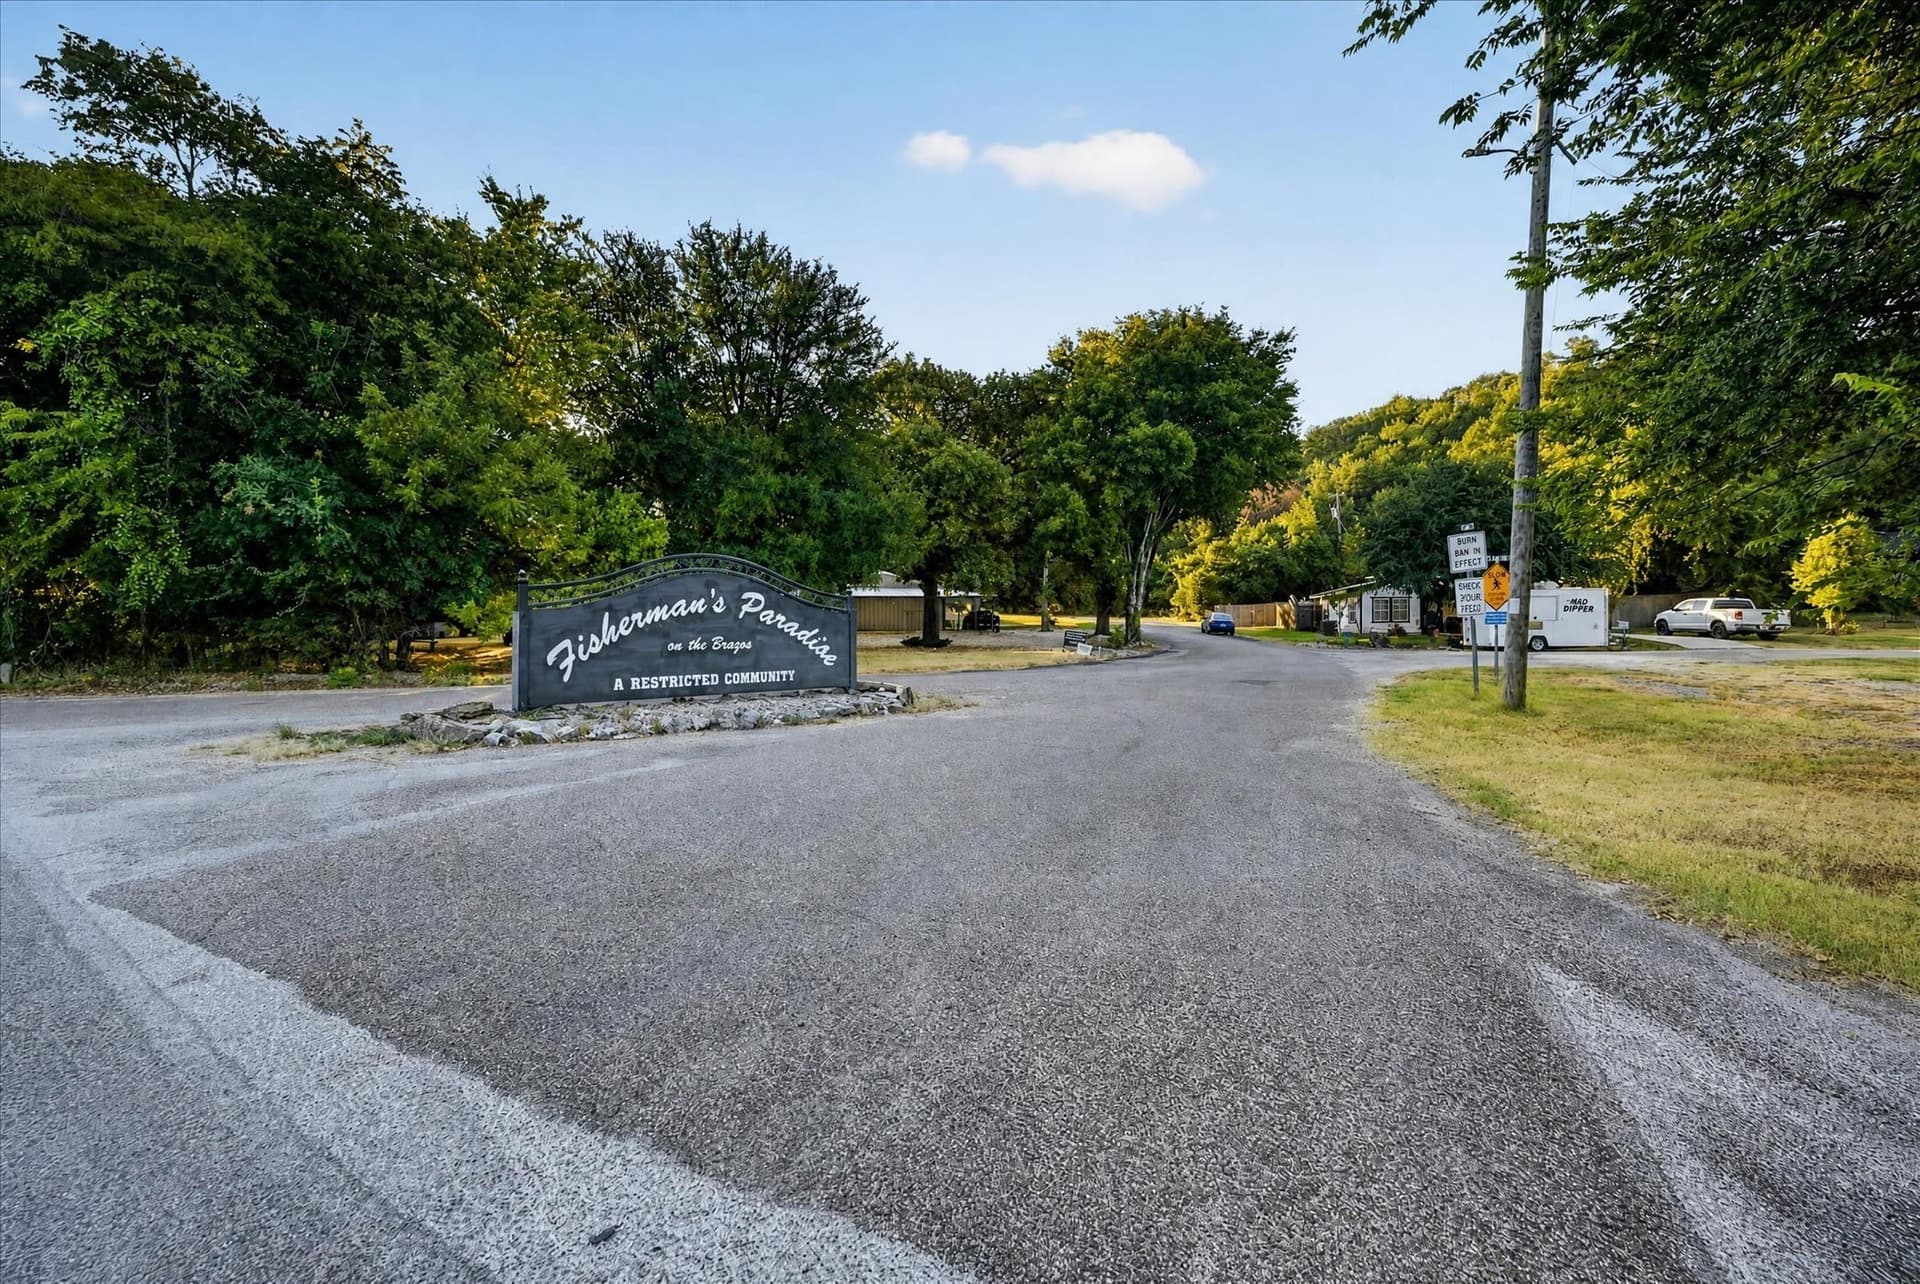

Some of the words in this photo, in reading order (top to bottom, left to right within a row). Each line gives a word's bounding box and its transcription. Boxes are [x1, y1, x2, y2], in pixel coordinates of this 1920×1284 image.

[1457, 535, 1477, 546] BURN
[1454, 548, 1470, 558] BAN
[1473, 547, 1481, 555] IN
[1454, 557, 1482, 569] EFFECT
[1487, 571, 1507, 579] SLOW
[1563, 605, 1594, 613] DIPPER
[546, 588, 727, 683] Fisherman's
[738, 591, 837, 666] Paradise
[667, 641, 683, 652] on
[688, 636, 707, 651] the
[711, 636, 753, 654] Brazos
[613, 678, 624, 691] A
[630, 673, 719, 690] RESTRICTED
[724, 670, 796, 685] COMMUNITY
